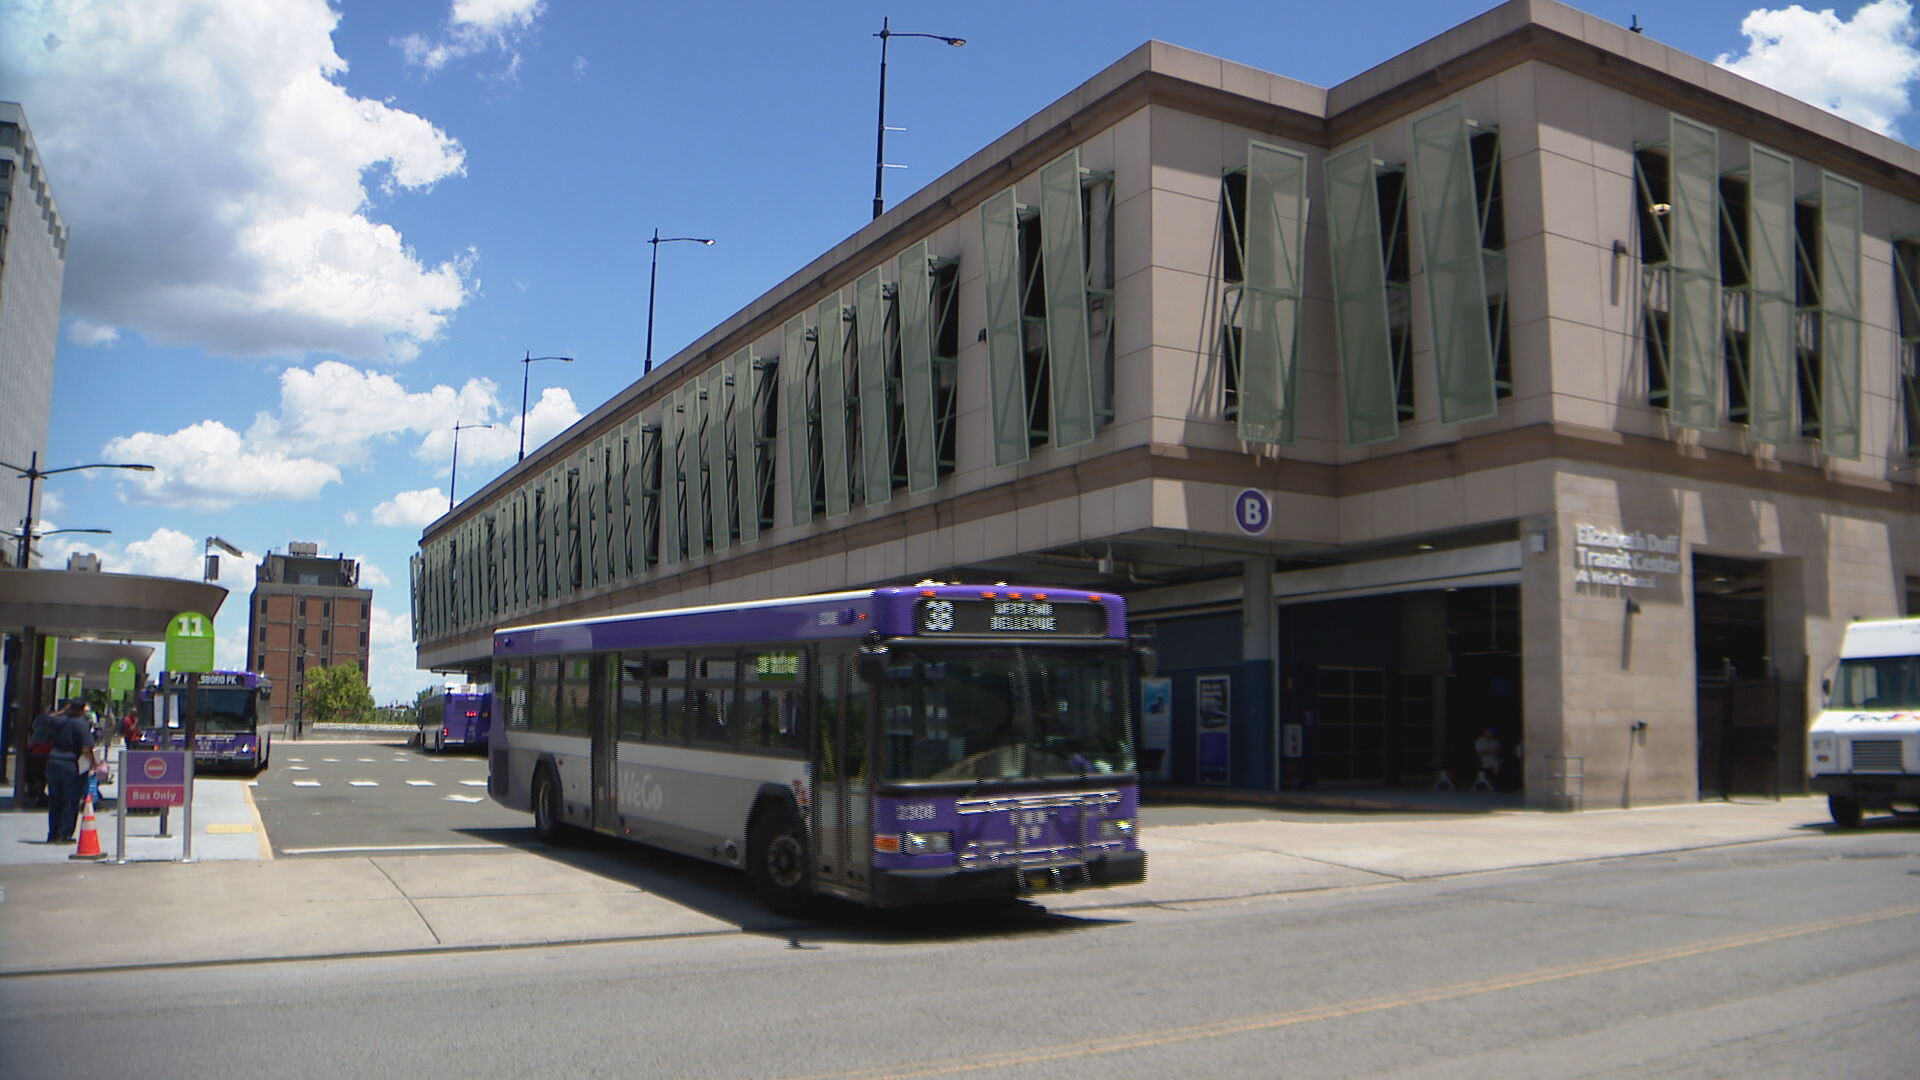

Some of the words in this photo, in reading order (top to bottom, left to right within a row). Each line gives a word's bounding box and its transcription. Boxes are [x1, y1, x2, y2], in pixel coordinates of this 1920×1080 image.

[1244, 498, 1262, 525] B
[1577, 524, 1647, 550] Elizabeth
[1576, 547, 1632, 570] Transit
[1633, 553, 1681, 573] Center
[924, 601, 954, 631] 3B
[994, 603, 1027, 615] WEST
[1027, 604, 1053, 615] END
[178, 616, 204, 637] 11
[990, 617, 1057, 631] BELLEVUE
[119, 661, 128, 673] 9
[132, 791, 151, 801] Bus
[153, 790, 176, 802] Only
[617, 770, 663, 811] WeGo
[896, 805, 937, 821] 2308
